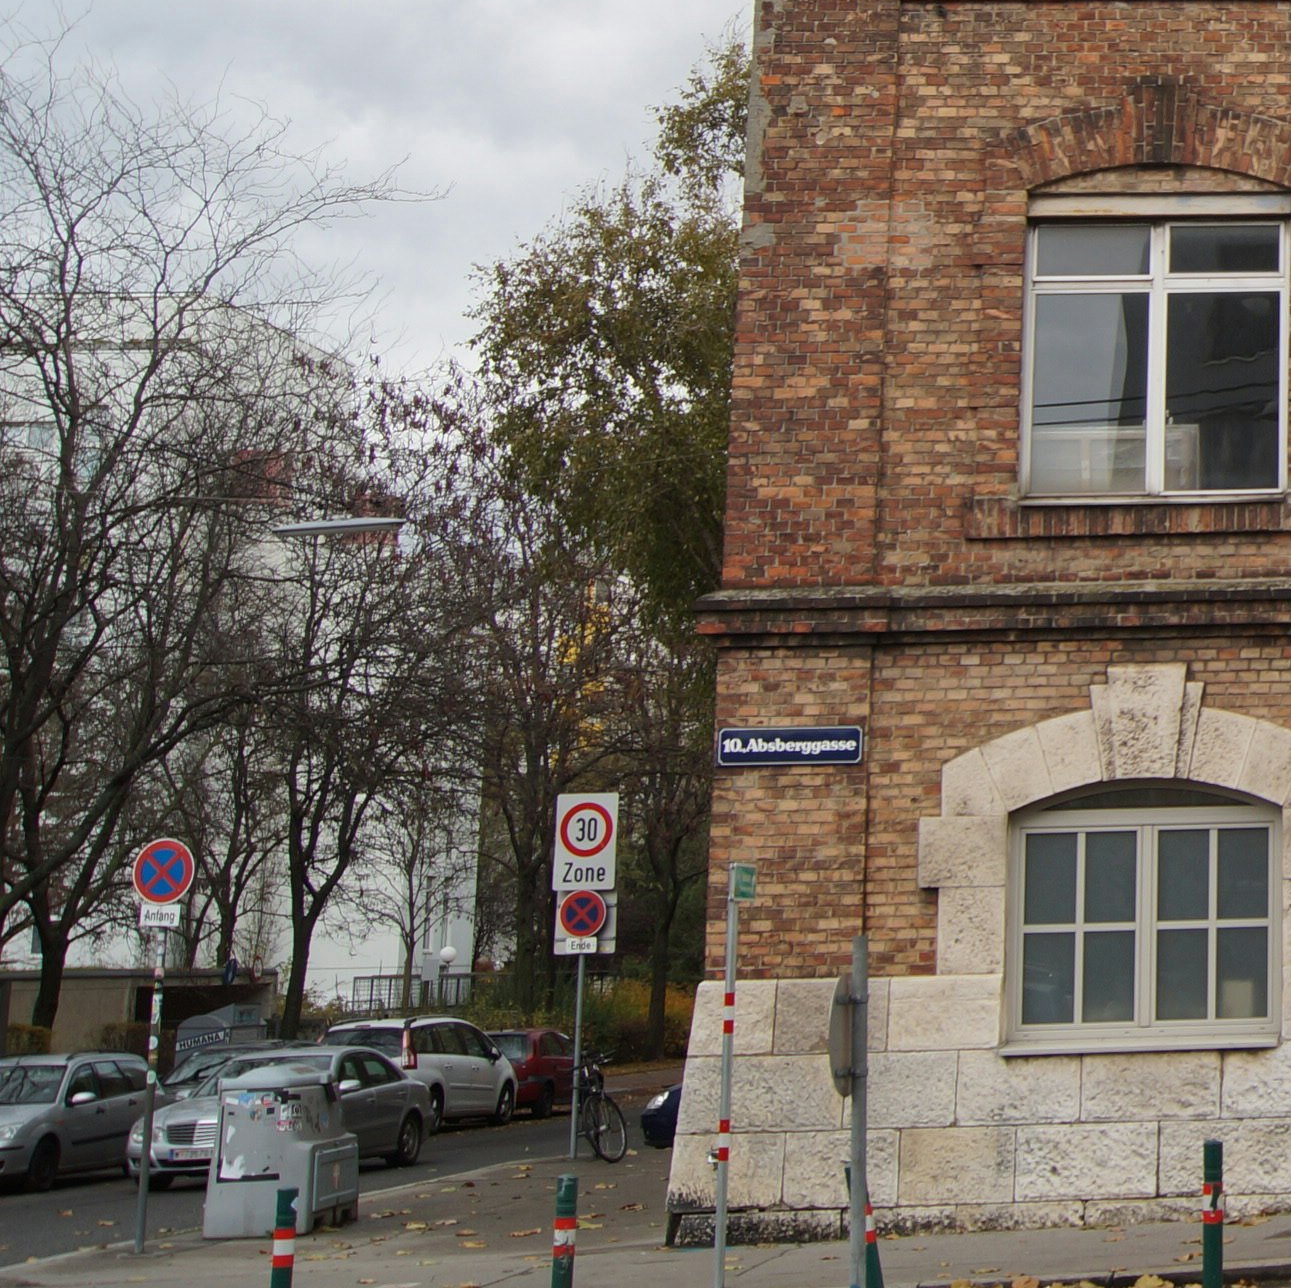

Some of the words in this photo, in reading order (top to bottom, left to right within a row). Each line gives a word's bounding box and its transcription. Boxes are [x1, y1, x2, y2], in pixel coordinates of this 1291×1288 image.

[745, 738, 857, 755] Absberggasse
[575, 817, 599, 842] 30
[562, 862, 606, 883] Zone
[144, 909, 175, 924] Anfang
[570, 940, 591, 950] Ende
